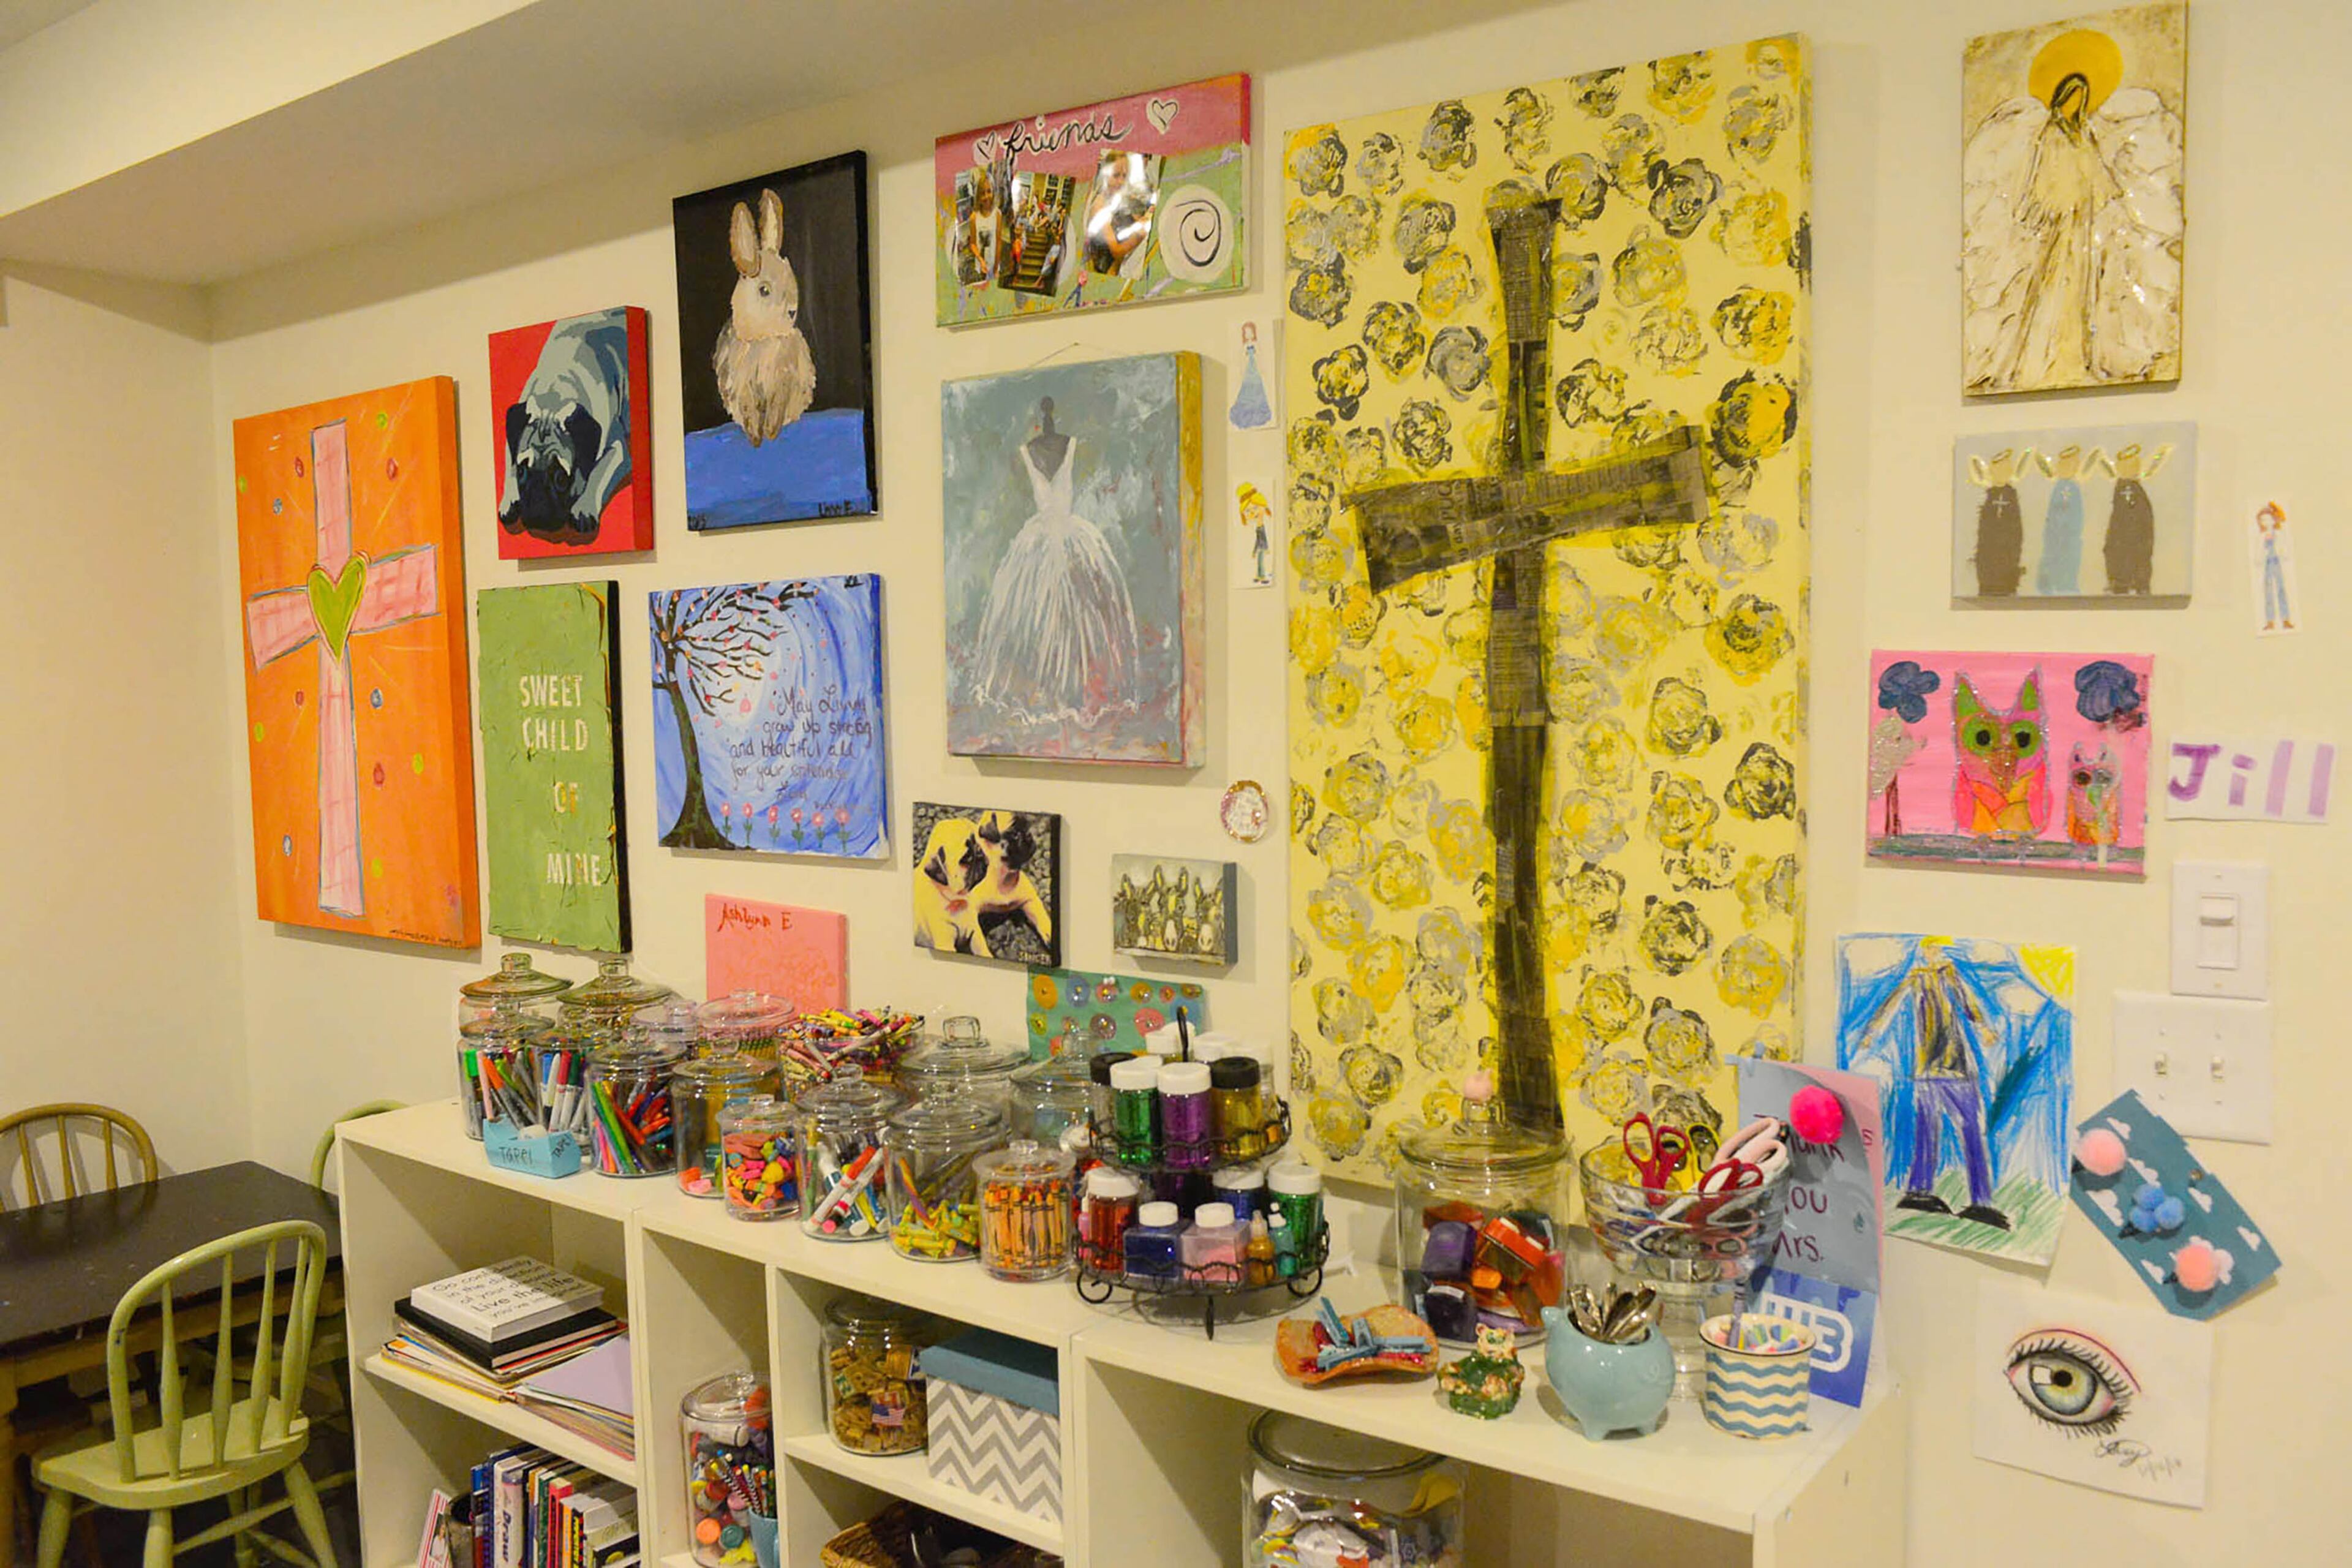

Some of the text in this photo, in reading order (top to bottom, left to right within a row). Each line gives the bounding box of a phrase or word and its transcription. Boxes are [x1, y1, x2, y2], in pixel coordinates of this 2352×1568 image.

[519, 675, 583, 707] SWEET
[777, 686, 814, 723] May
[522, 717, 589, 751] CHILD
[729, 737, 754, 758] and
[828, 739, 856, 759] all
[763, 720, 795, 744] grow
[2168, 740, 2335, 818] Jill
[554, 781, 579, 814] OF
[547, 853, 603, 886] MINE
[781, 911, 793, 931] E
